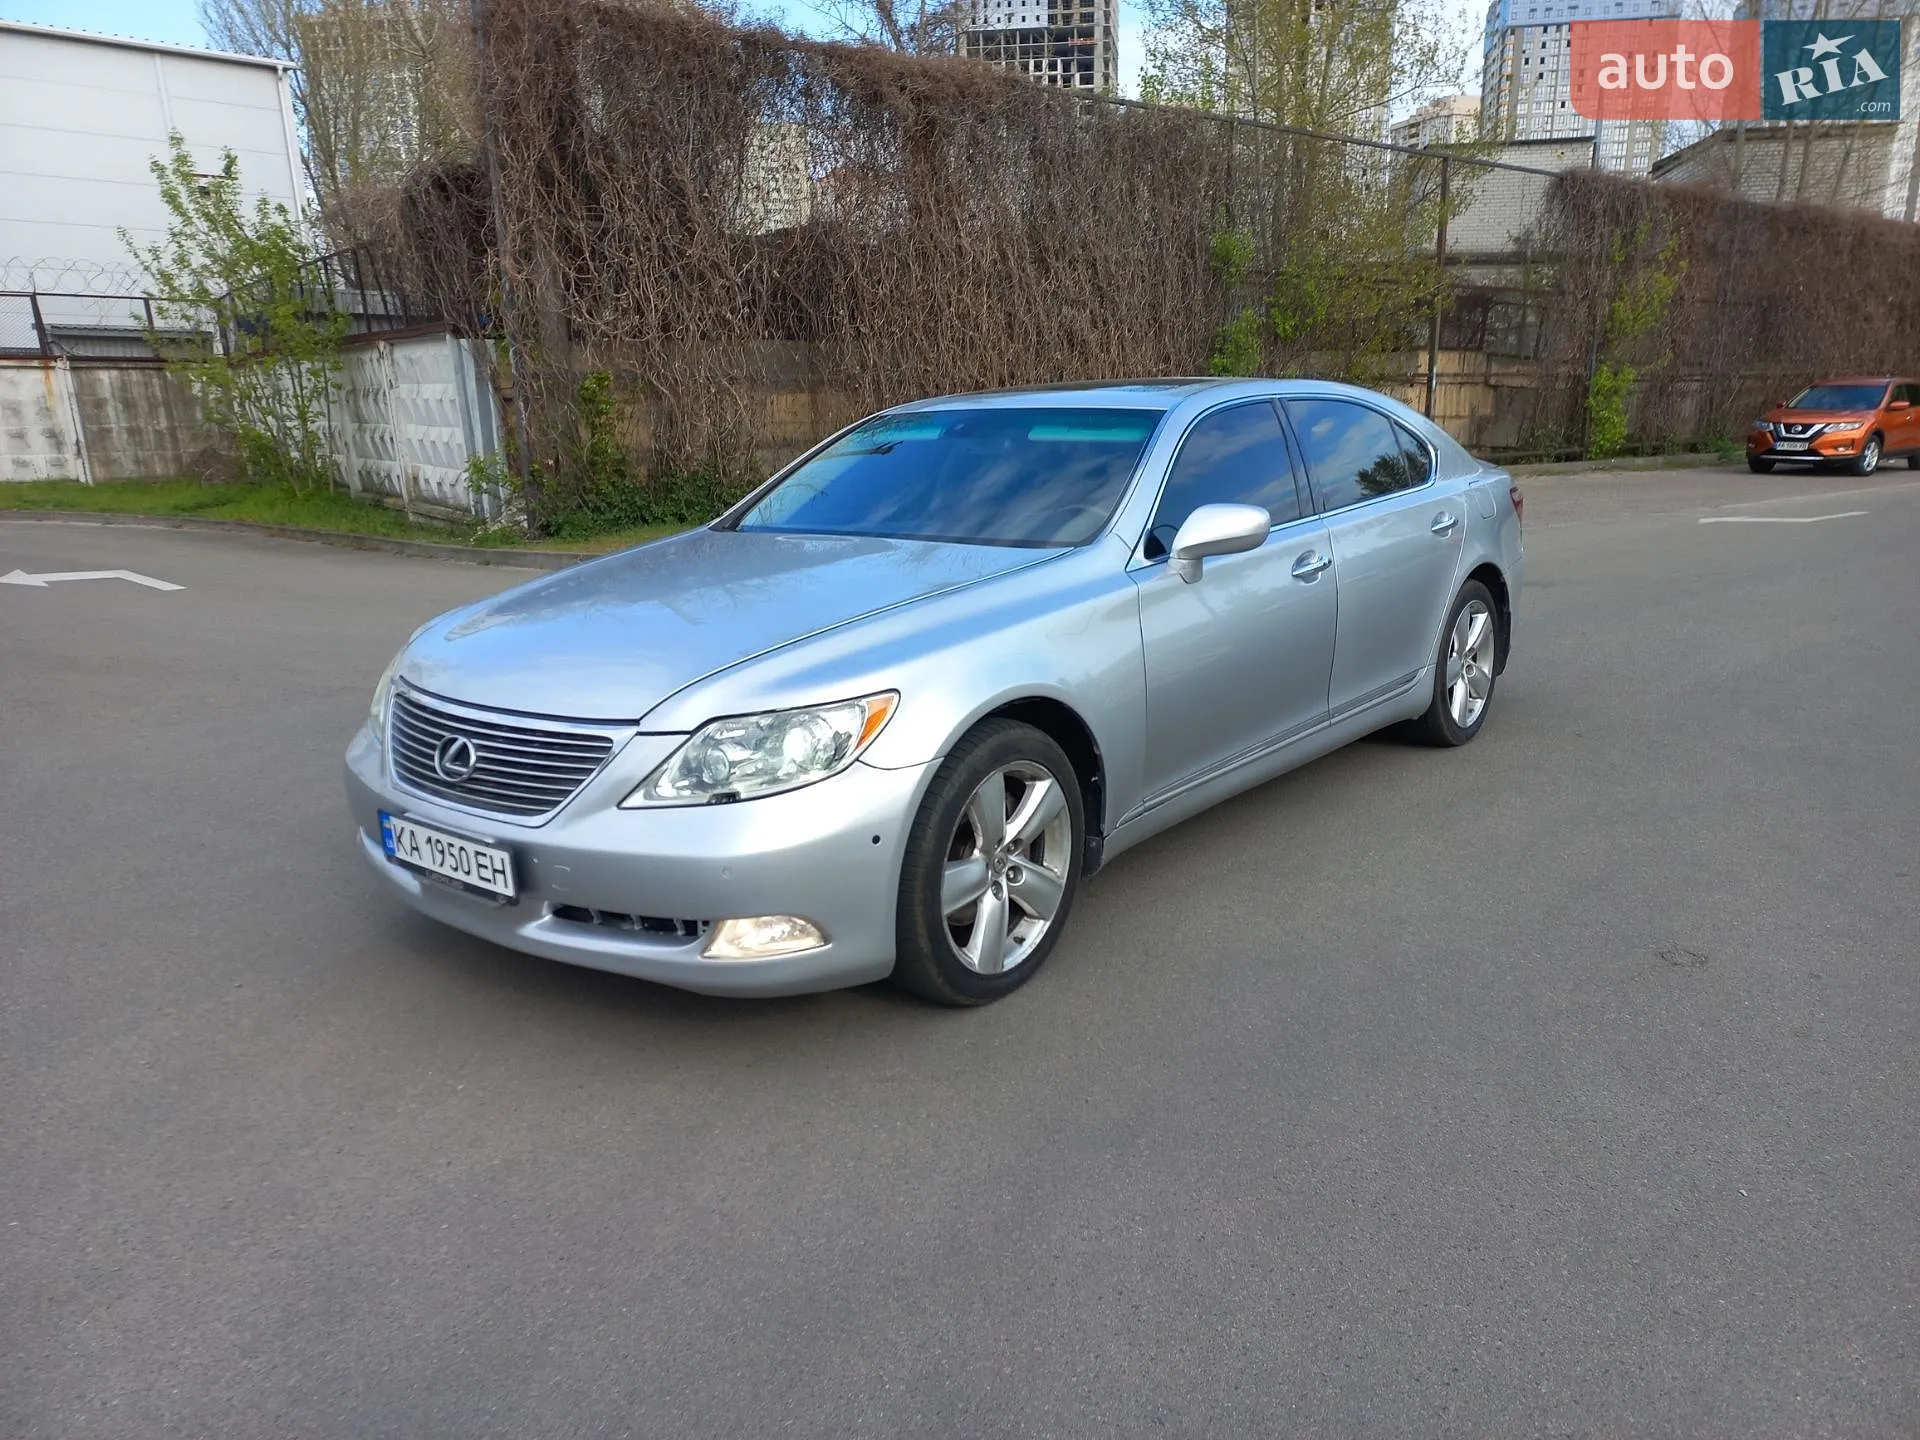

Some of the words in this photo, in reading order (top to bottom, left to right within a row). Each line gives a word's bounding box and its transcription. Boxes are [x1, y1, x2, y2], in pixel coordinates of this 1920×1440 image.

[393, 824, 422, 861] KA
[425, 836, 471, 876] 1950
[474, 850, 508, 889] EH
